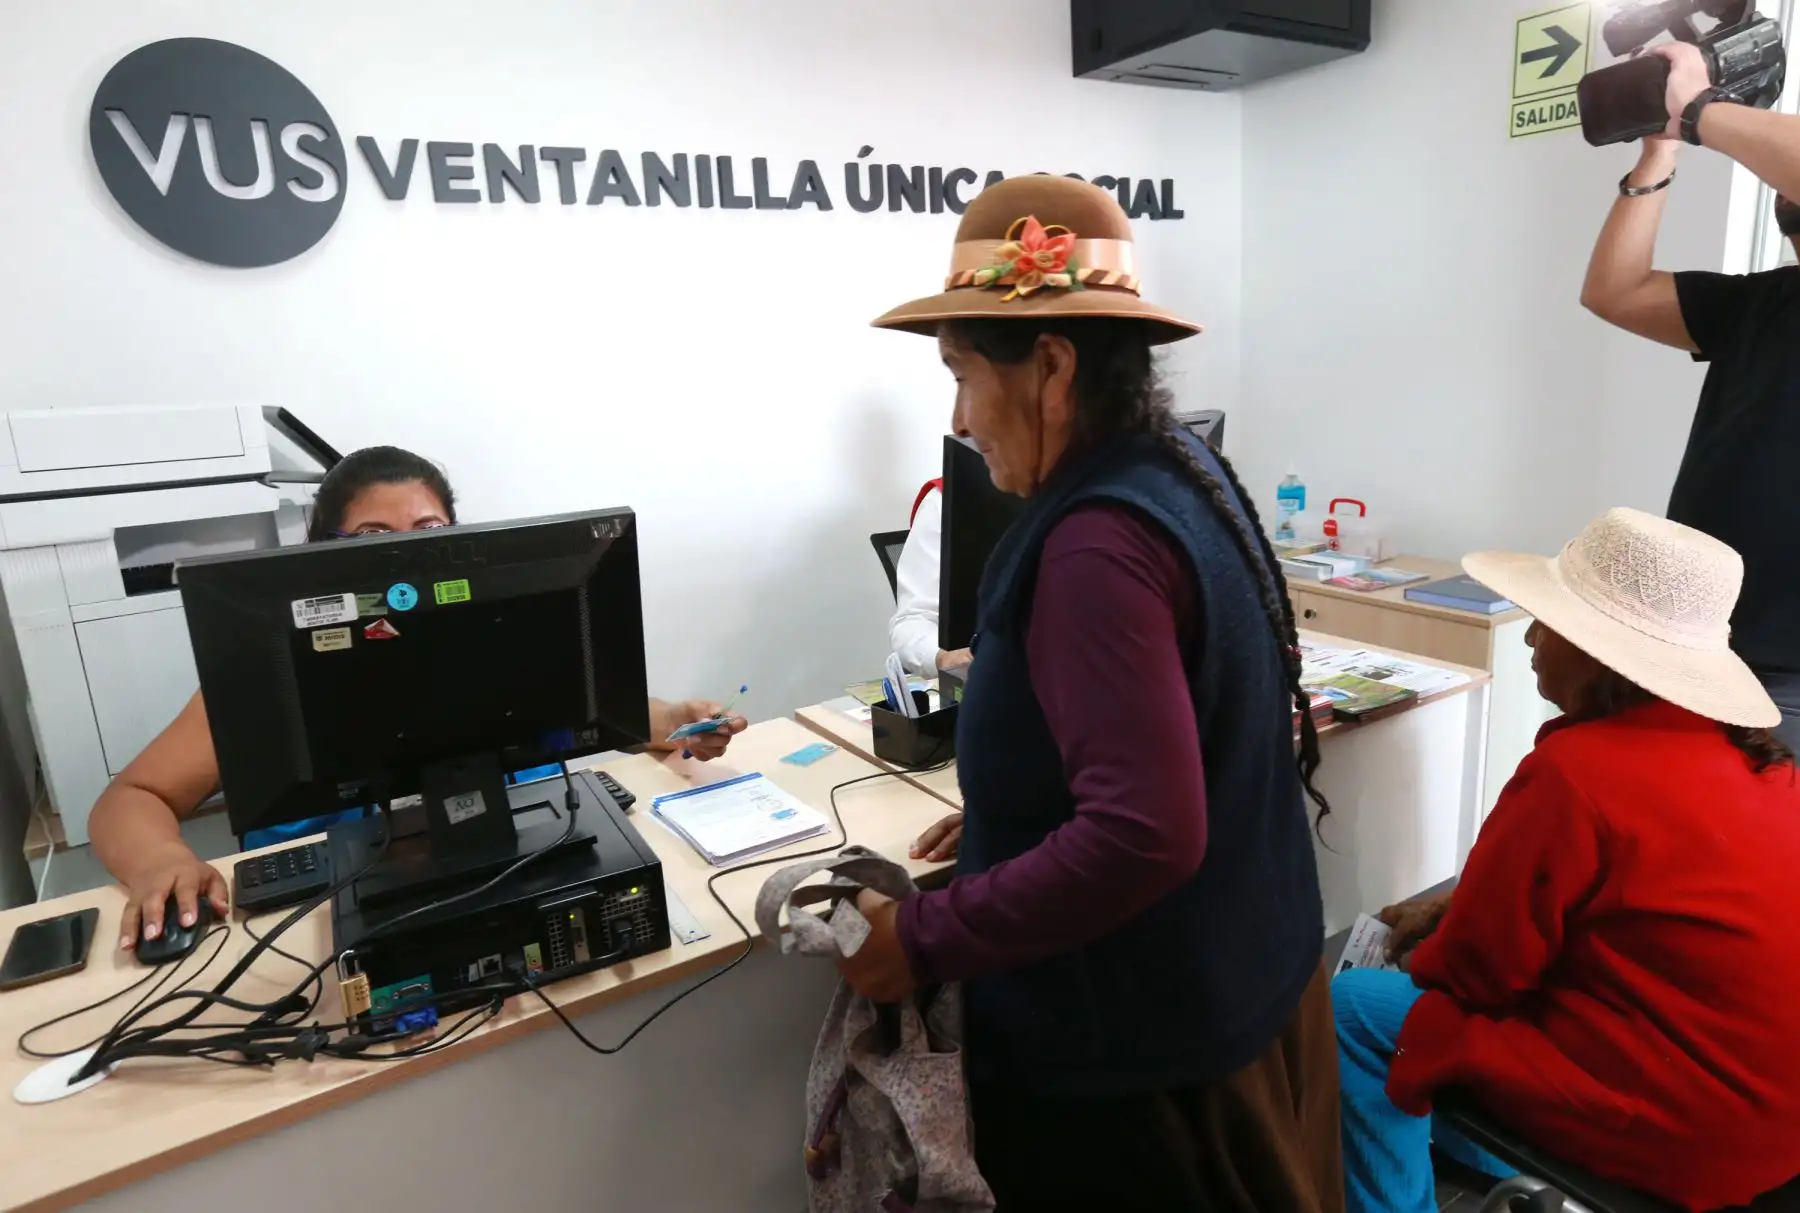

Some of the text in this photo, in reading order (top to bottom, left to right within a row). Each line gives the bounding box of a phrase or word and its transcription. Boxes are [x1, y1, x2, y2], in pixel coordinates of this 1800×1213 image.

[104, 107, 340, 202] VUS
[1515, 100, 1578, 128] SALIDA
[357, 136, 833, 211] VENTANILLA
[1028, 171, 1185, 220] IAL
